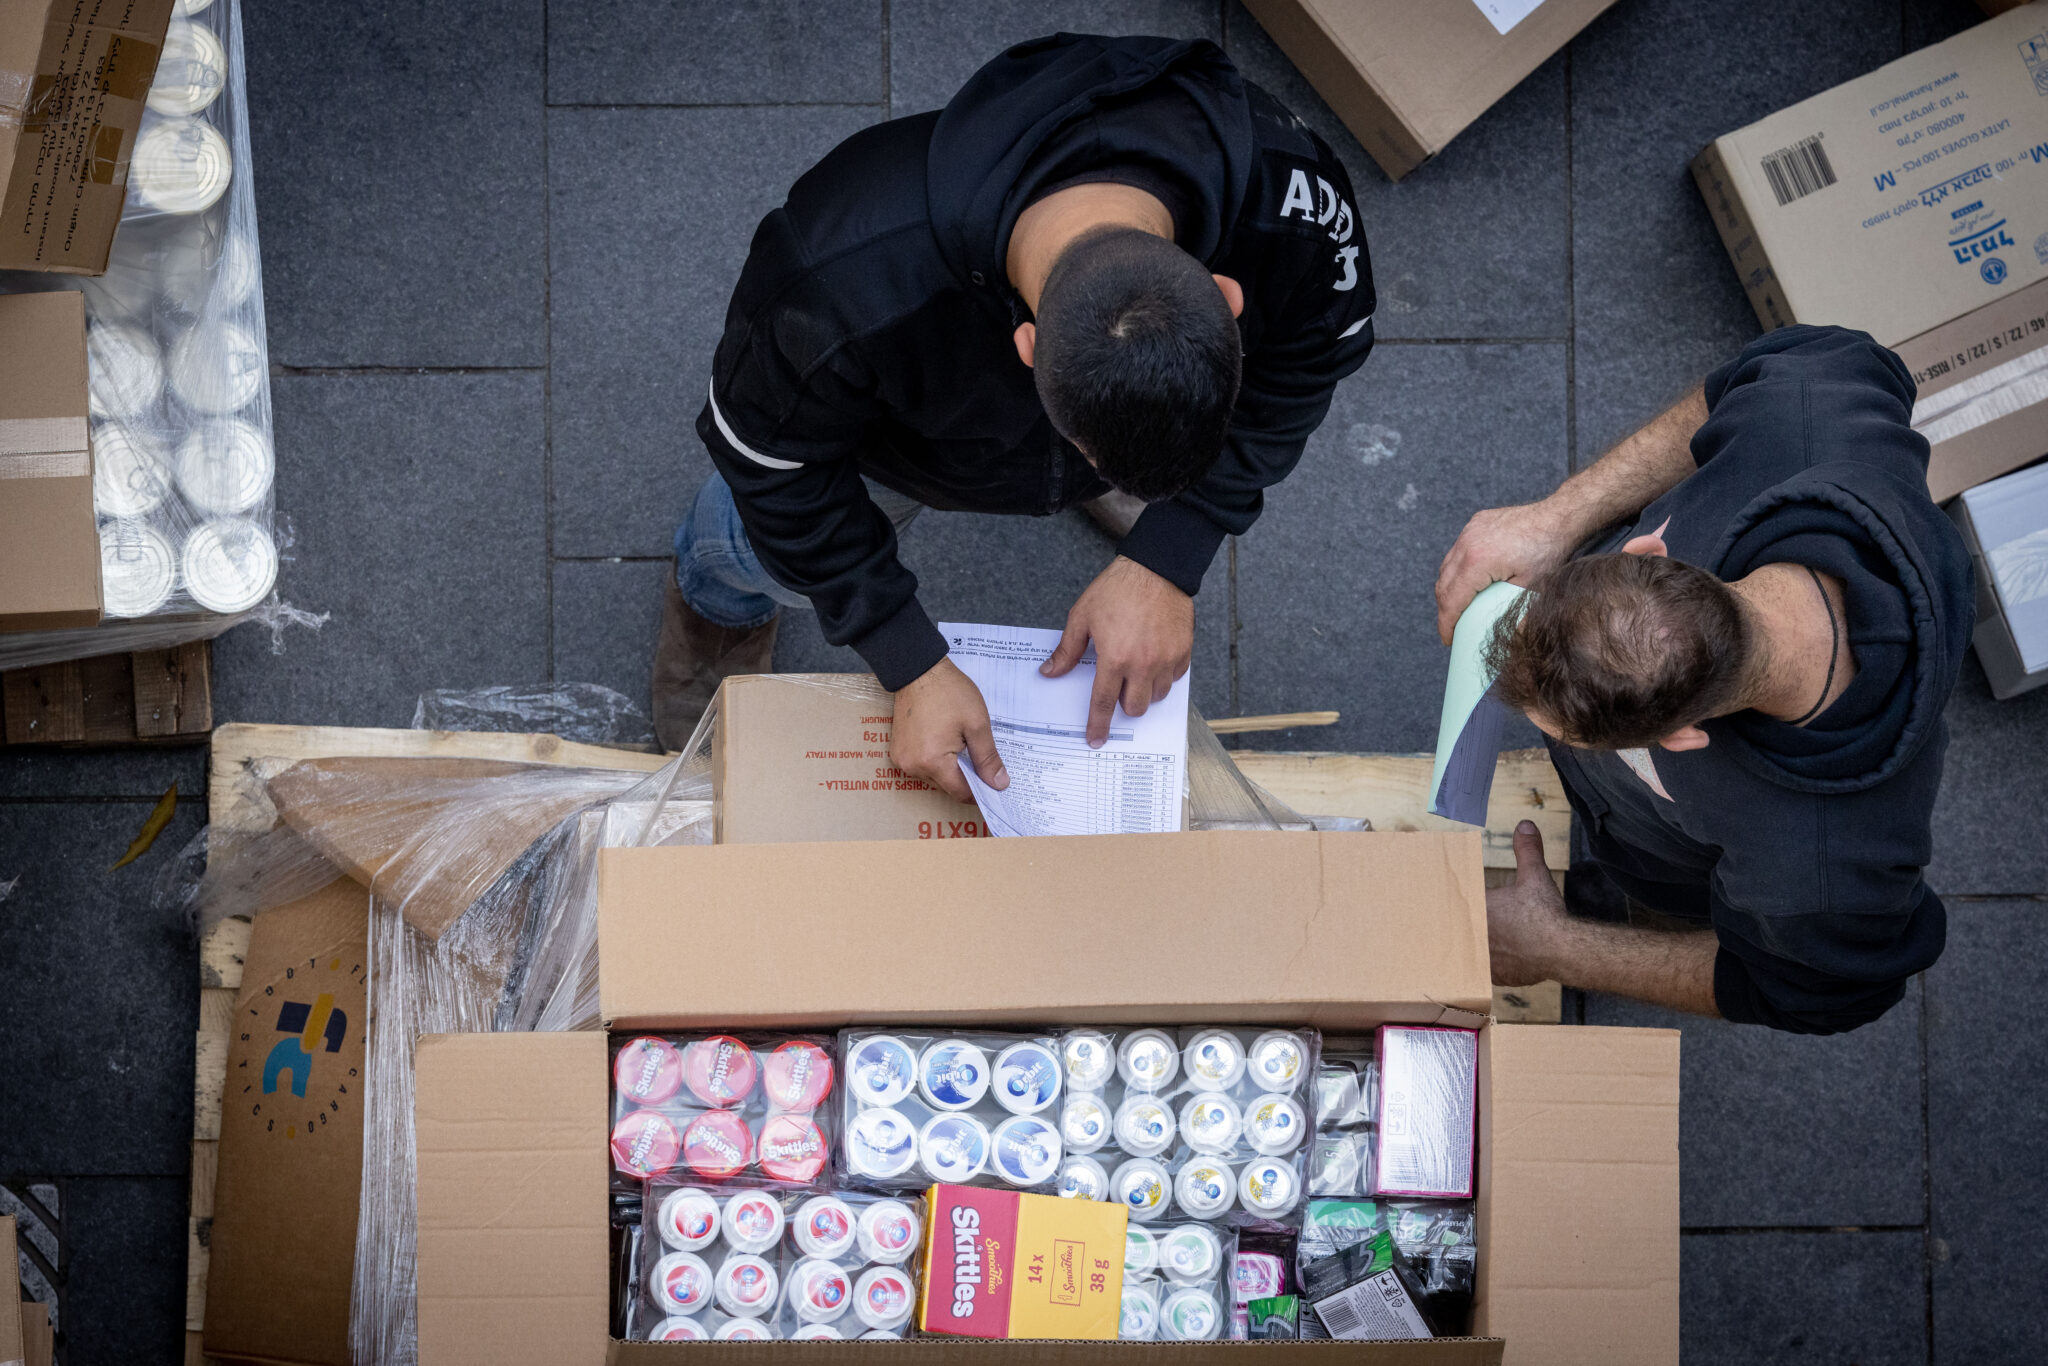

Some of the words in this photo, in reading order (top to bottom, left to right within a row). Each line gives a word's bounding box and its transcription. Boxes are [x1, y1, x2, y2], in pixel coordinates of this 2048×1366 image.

[1869, 72, 1960, 118] www.hanamal.co.il
[1927, 113, 1965, 137] 400080
[1980, 118, 2011, 139] LATEX
[1941, 132, 1980, 156] GLOVES
[1903, 158, 1922, 173] PCS
[1923, 149, 1941, 165] 100
[1995, 157, 2016, 173] 100
[2030, 142, 2048, 164] M
[47, 154, 62, 206] Noodle
[76, 158, 90, 199] China
[1873, 170, 1896, 192] M
[1953, 229, 2015, 265] הנמל
[2030, 317, 2046, 333] 4G
[1973, 342, 1988, 359] 22
[1993, 336, 2003, 349] S
[1957, 352, 1967, 366] S
[805, 751, 826, 759] ITALY
[839, 751, 863, 759] MADE
[871, 780, 891, 791] AND
[895, 780, 930, 791] CRISPS
[636, 1047, 664, 1097] Skittles
[709, 1043, 733, 1093] Skittles
[788, 1049, 811, 1100] Skittles
[630, 1118, 661, 1166] Skittles
[698, 1125, 741, 1164] Skittles
[766, 1142, 818, 1159] Skittles
[950, 1206, 982, 1318] Skittles
[985, 1238, 1003, 1295] Smoothies
[1060, 1245, 1076, 1294] Smoothies
[1095, 1258, 1110, 1269] g
[1028, 1264, 1043, 1284] 14
[1090, 1273, 1105, 1293] 38
